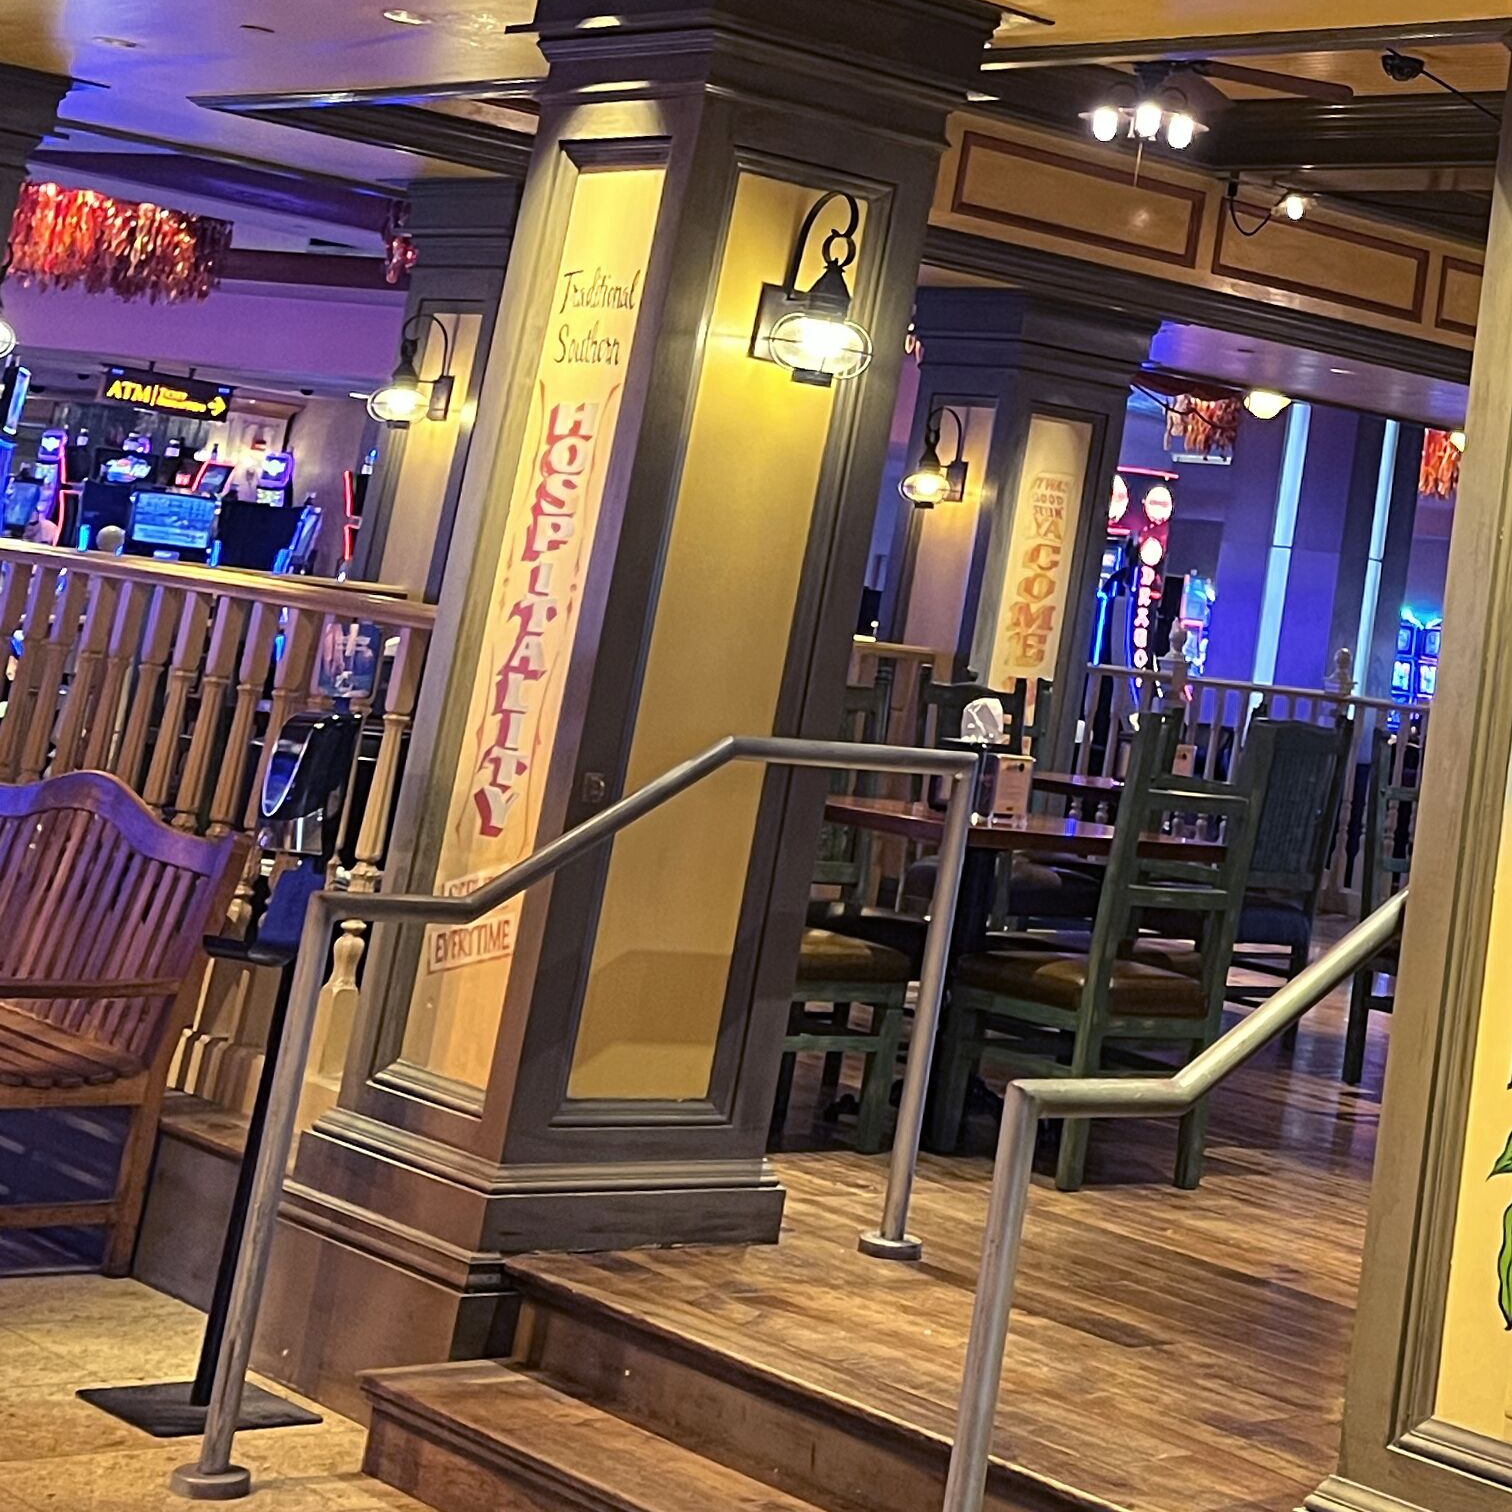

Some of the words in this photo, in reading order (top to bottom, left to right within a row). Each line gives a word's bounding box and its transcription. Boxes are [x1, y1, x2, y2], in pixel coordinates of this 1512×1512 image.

[559, 266, 641, 314] Traditional
[553, 320, 620, 366] Southern
[106, 379, 153, 404] ATM
[474, 402, 601, 838] HOSPITALITY
[1005, 543, 1062, 668] COME
[433, 919, 511, 963] EVERYTIME
